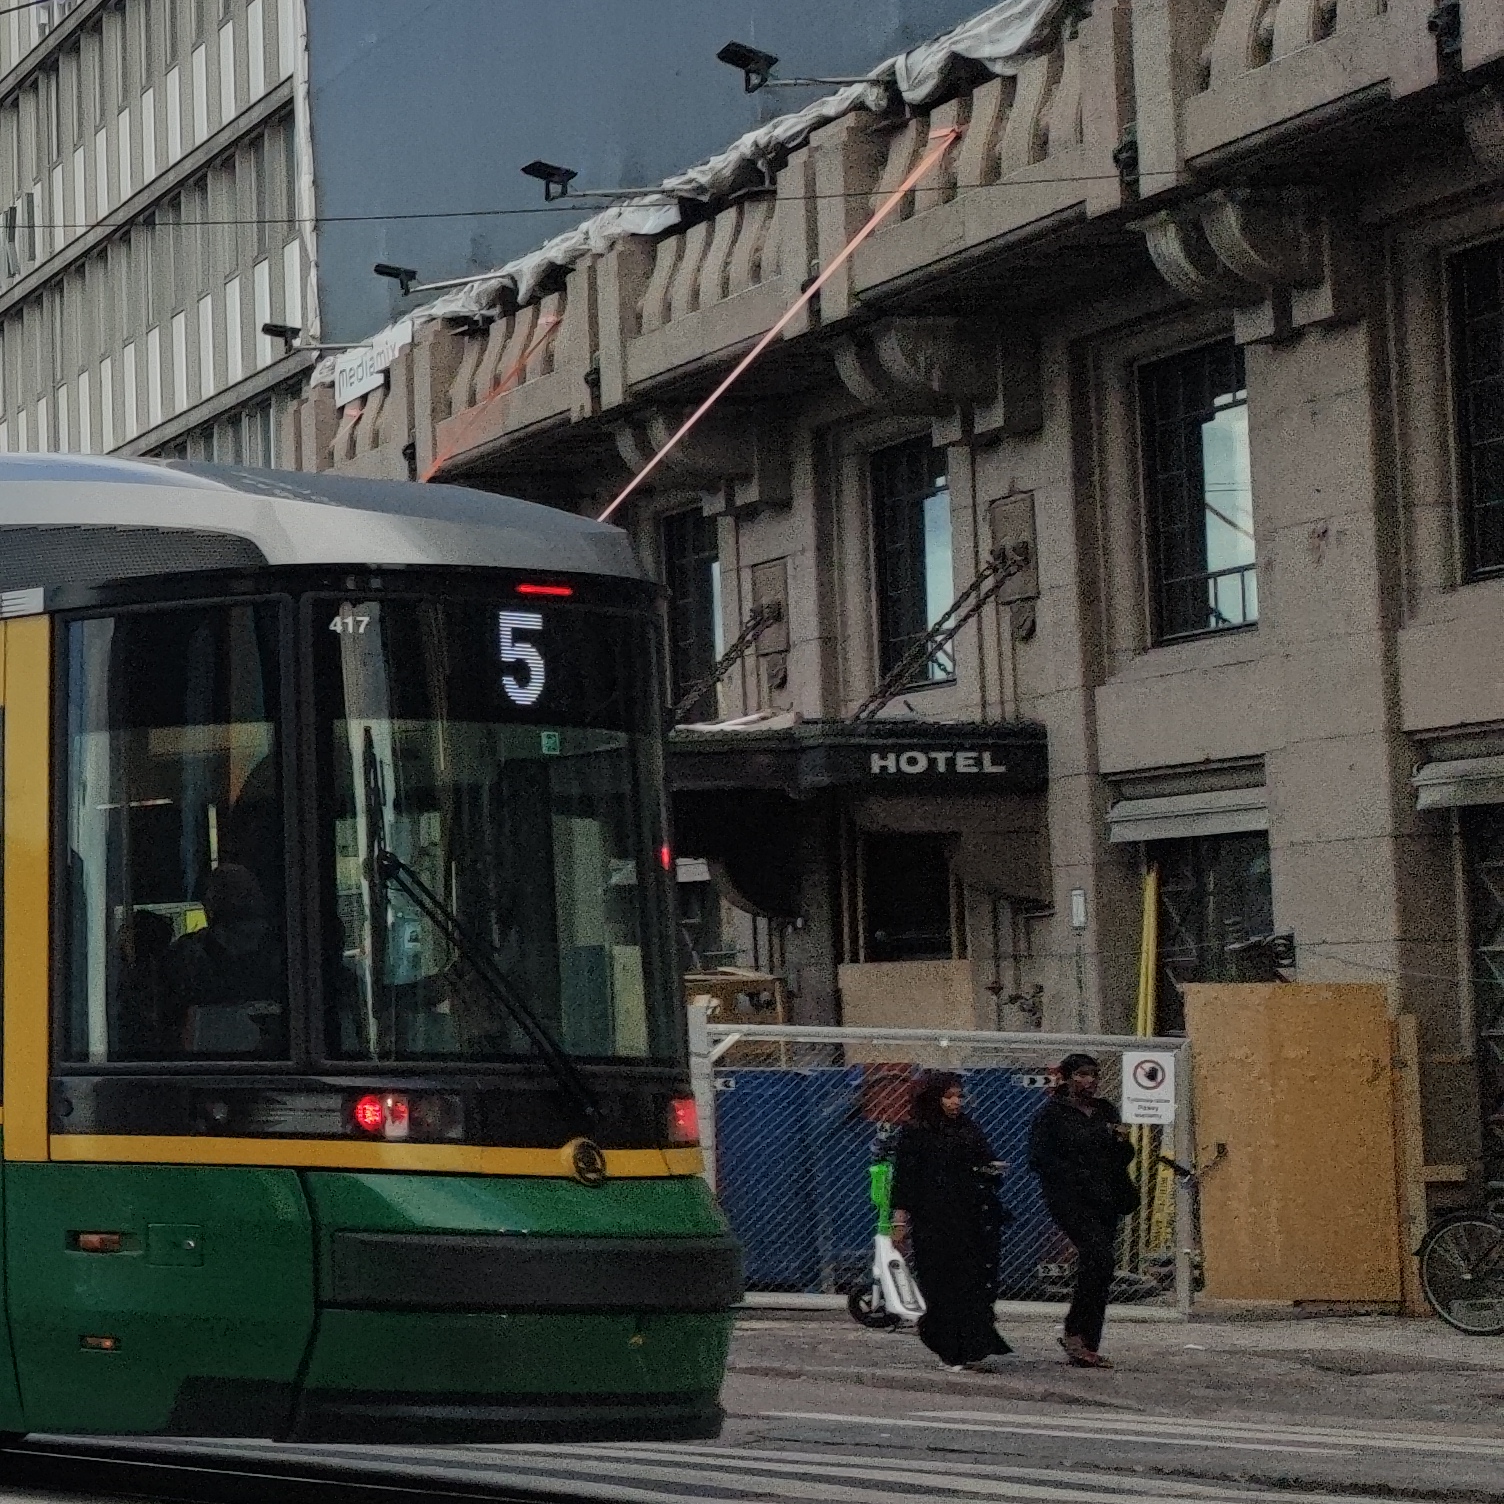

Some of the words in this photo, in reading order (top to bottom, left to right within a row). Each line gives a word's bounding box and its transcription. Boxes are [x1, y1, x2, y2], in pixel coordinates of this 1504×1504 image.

[329, 616, 370, 634] 417
[499, 611, 546, 705] 5
[870, 751, 1007, 774] HOTEL
